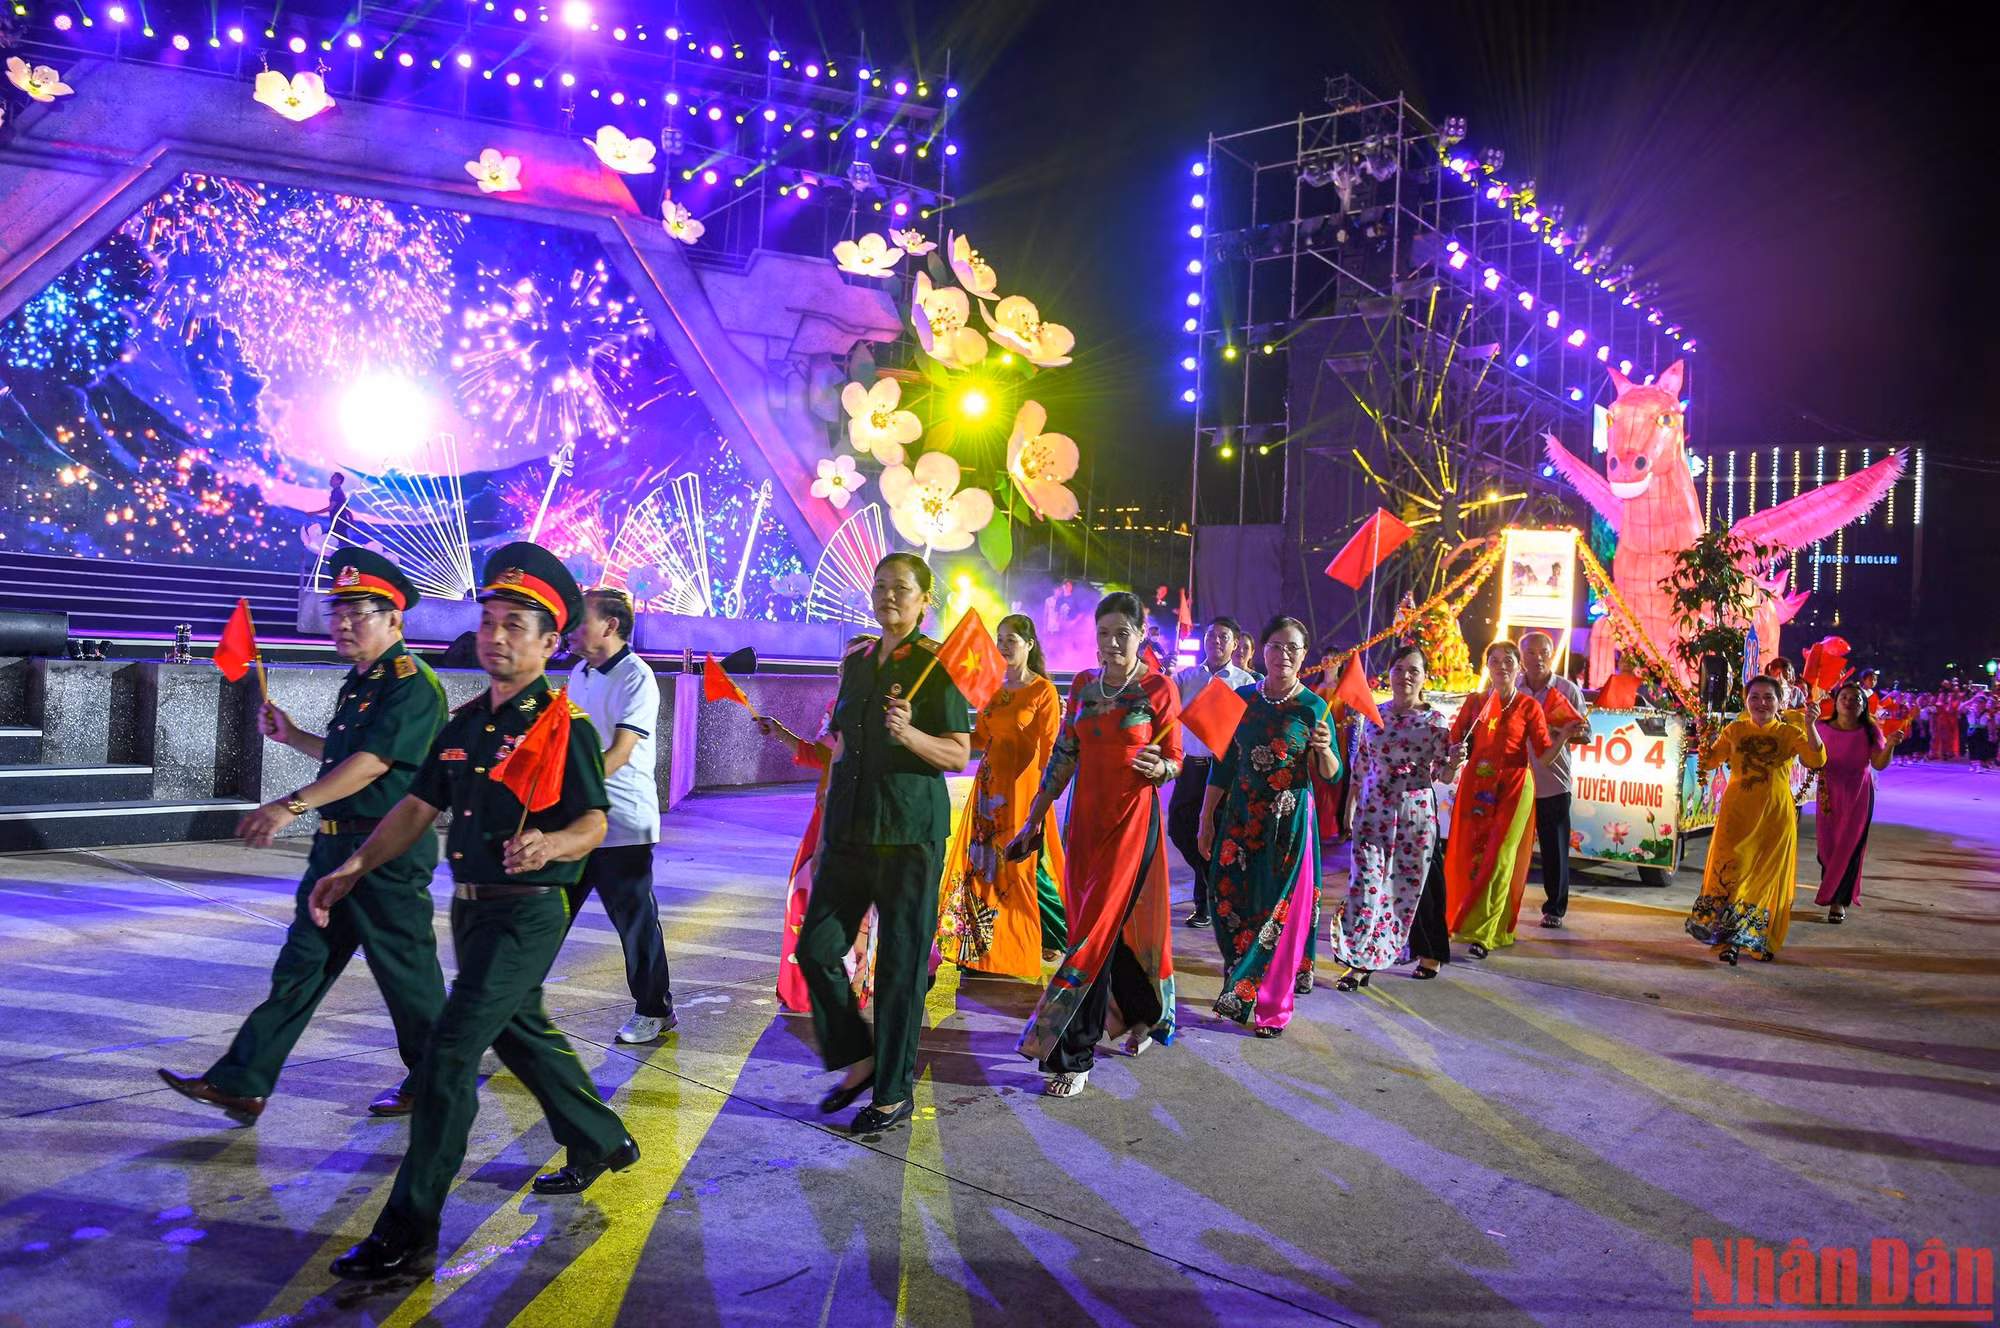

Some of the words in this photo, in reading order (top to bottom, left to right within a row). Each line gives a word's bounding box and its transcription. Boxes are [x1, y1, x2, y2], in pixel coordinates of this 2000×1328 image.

[1854, 555, 1898, 564] ENGLISH
[1644, 740, 1665, 769] 4
[1577, 774, 1616, 803] TUYÊN
[1619, 780, 1663, 808] QUANG
